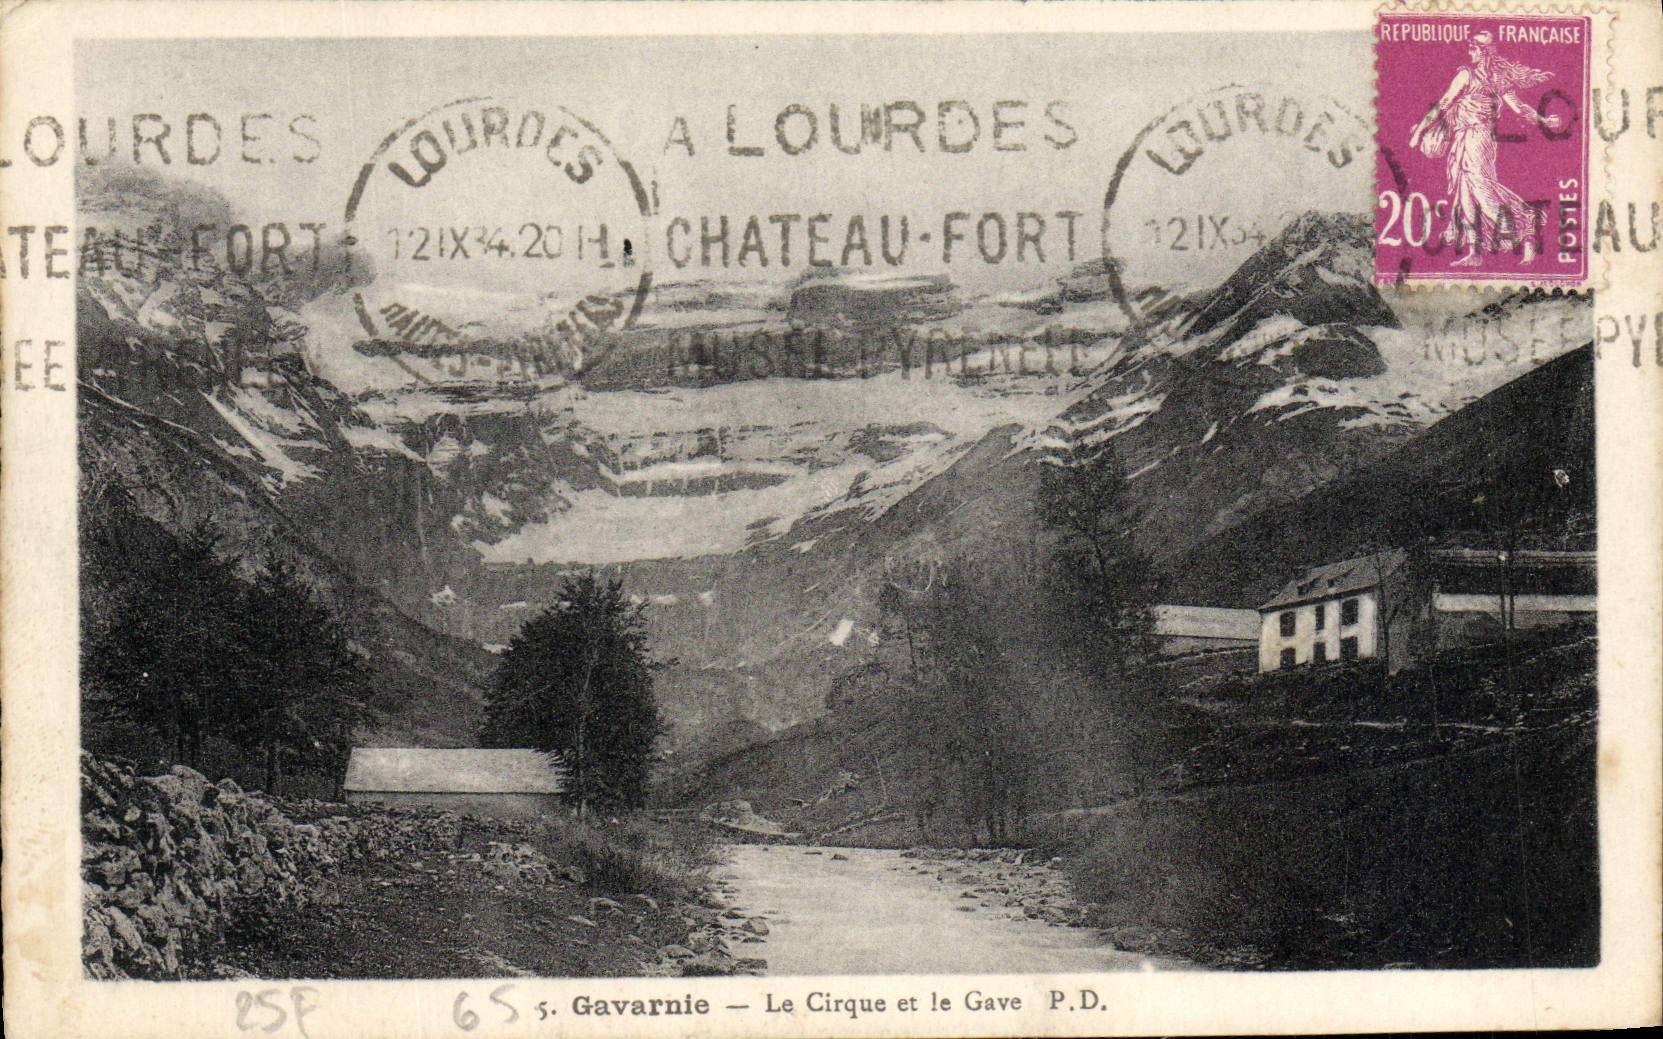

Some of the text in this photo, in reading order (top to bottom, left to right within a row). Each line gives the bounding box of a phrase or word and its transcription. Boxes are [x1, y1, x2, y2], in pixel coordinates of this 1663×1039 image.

[1498, 24, 1582, 45] FRANÇAISE
[387, 106, 604, 184] LOURDES
[663, 99, 1079, 158] A LOURDES
[1145, 92, 1366, 169] LOURDES
[1557, 178, 1579, 264] POSTES
[571, 994, 710, 1017] Gavarnie
[765, 993, 794, 1013] Le
[805, 992, 886, 1019] Cirque
[896, 994, 918, 1013] et
[930, 992, 951, 1013] le
[963, 991, 1023, 1012] Gave
[1048, 988, 1108, 1013] P.D.
